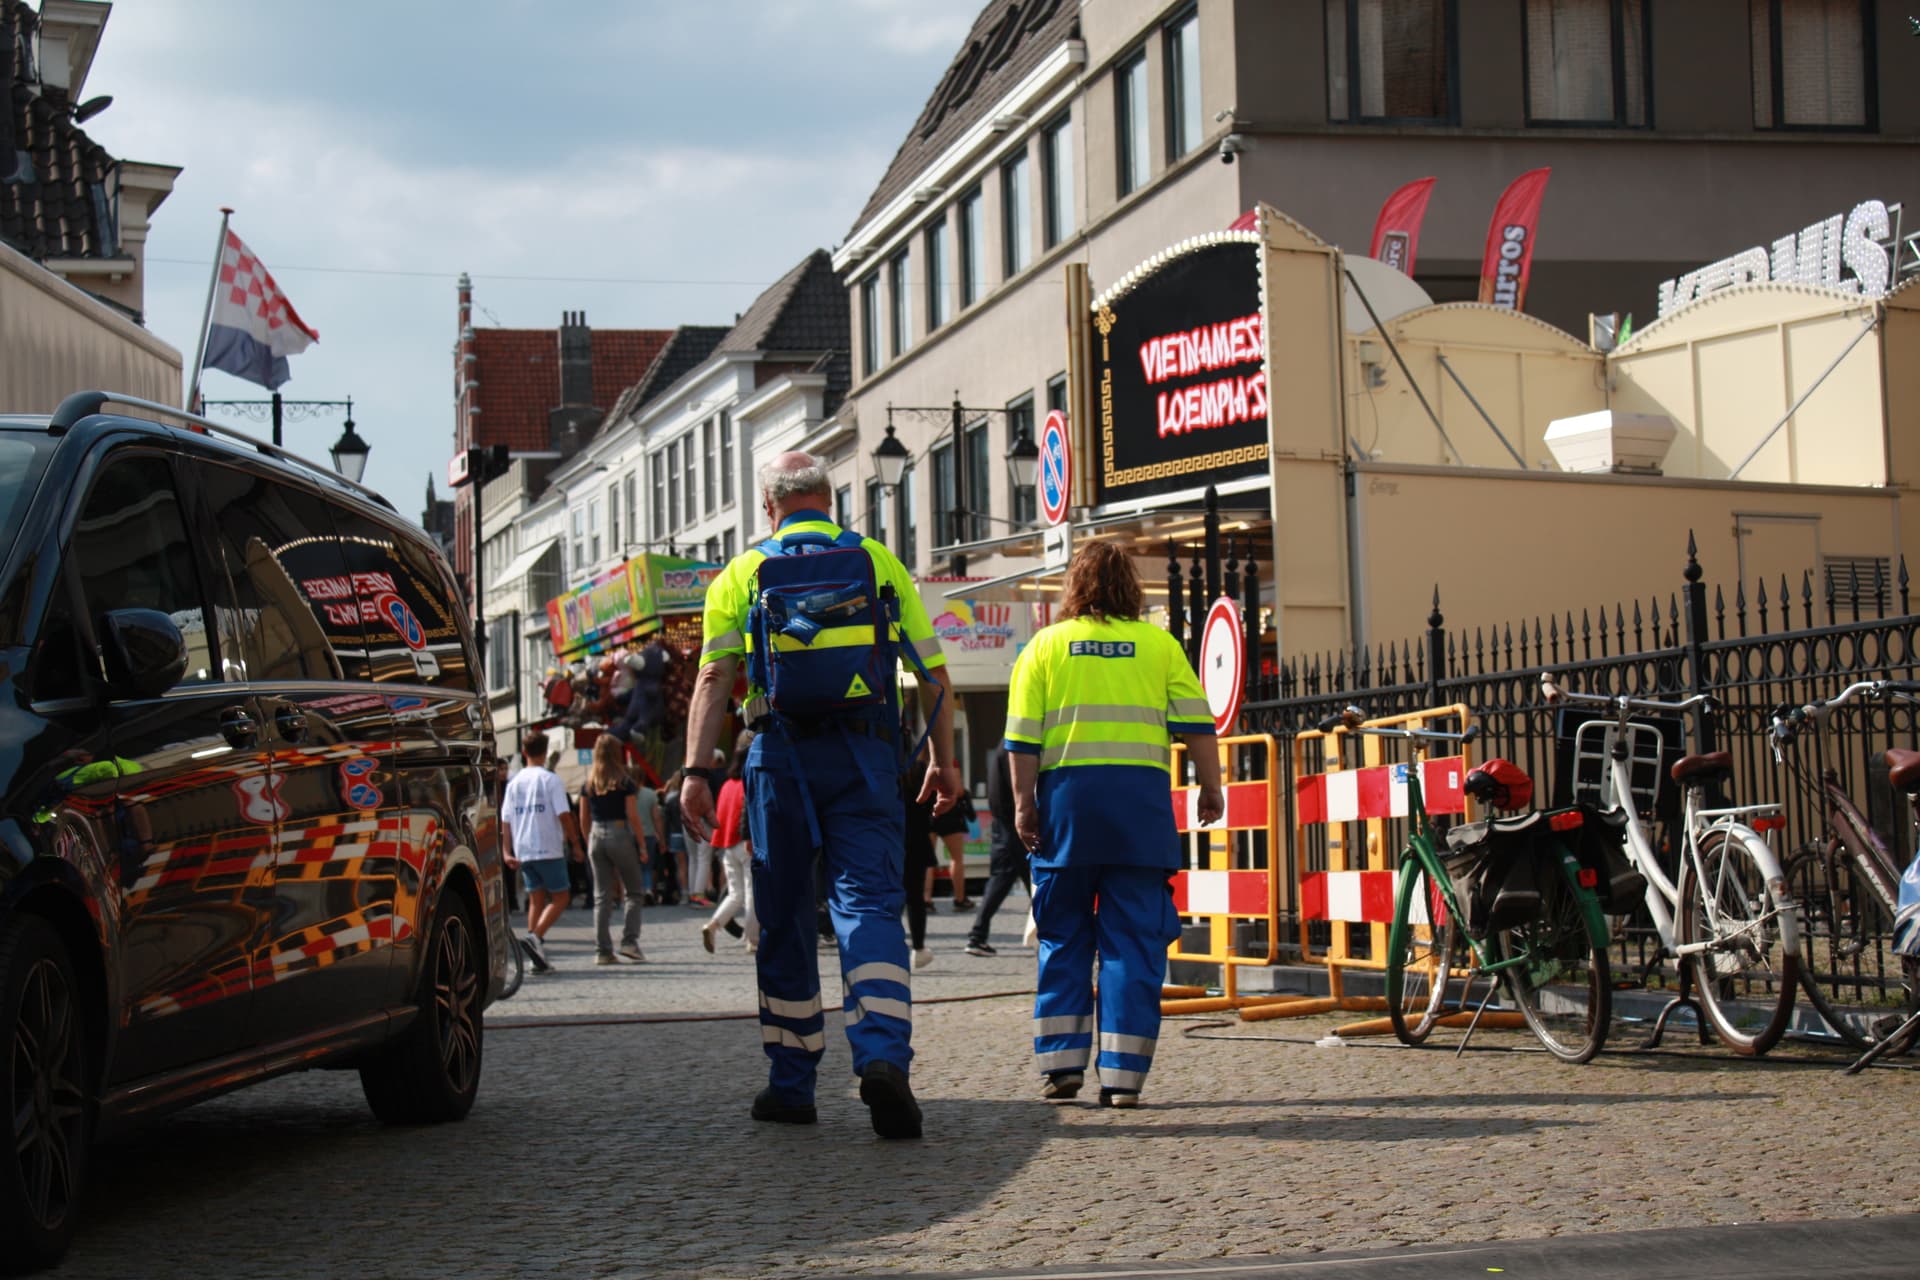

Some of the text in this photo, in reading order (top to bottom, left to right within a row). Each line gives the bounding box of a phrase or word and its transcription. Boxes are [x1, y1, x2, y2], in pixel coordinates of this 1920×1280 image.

[1139, 313, 1264, 385] VIETNAMES
[934, 621, 1015, 638] Cotton Candy
[960, 638, 994, 651] Store
[1071, 642, 1134, 656] EHBO
